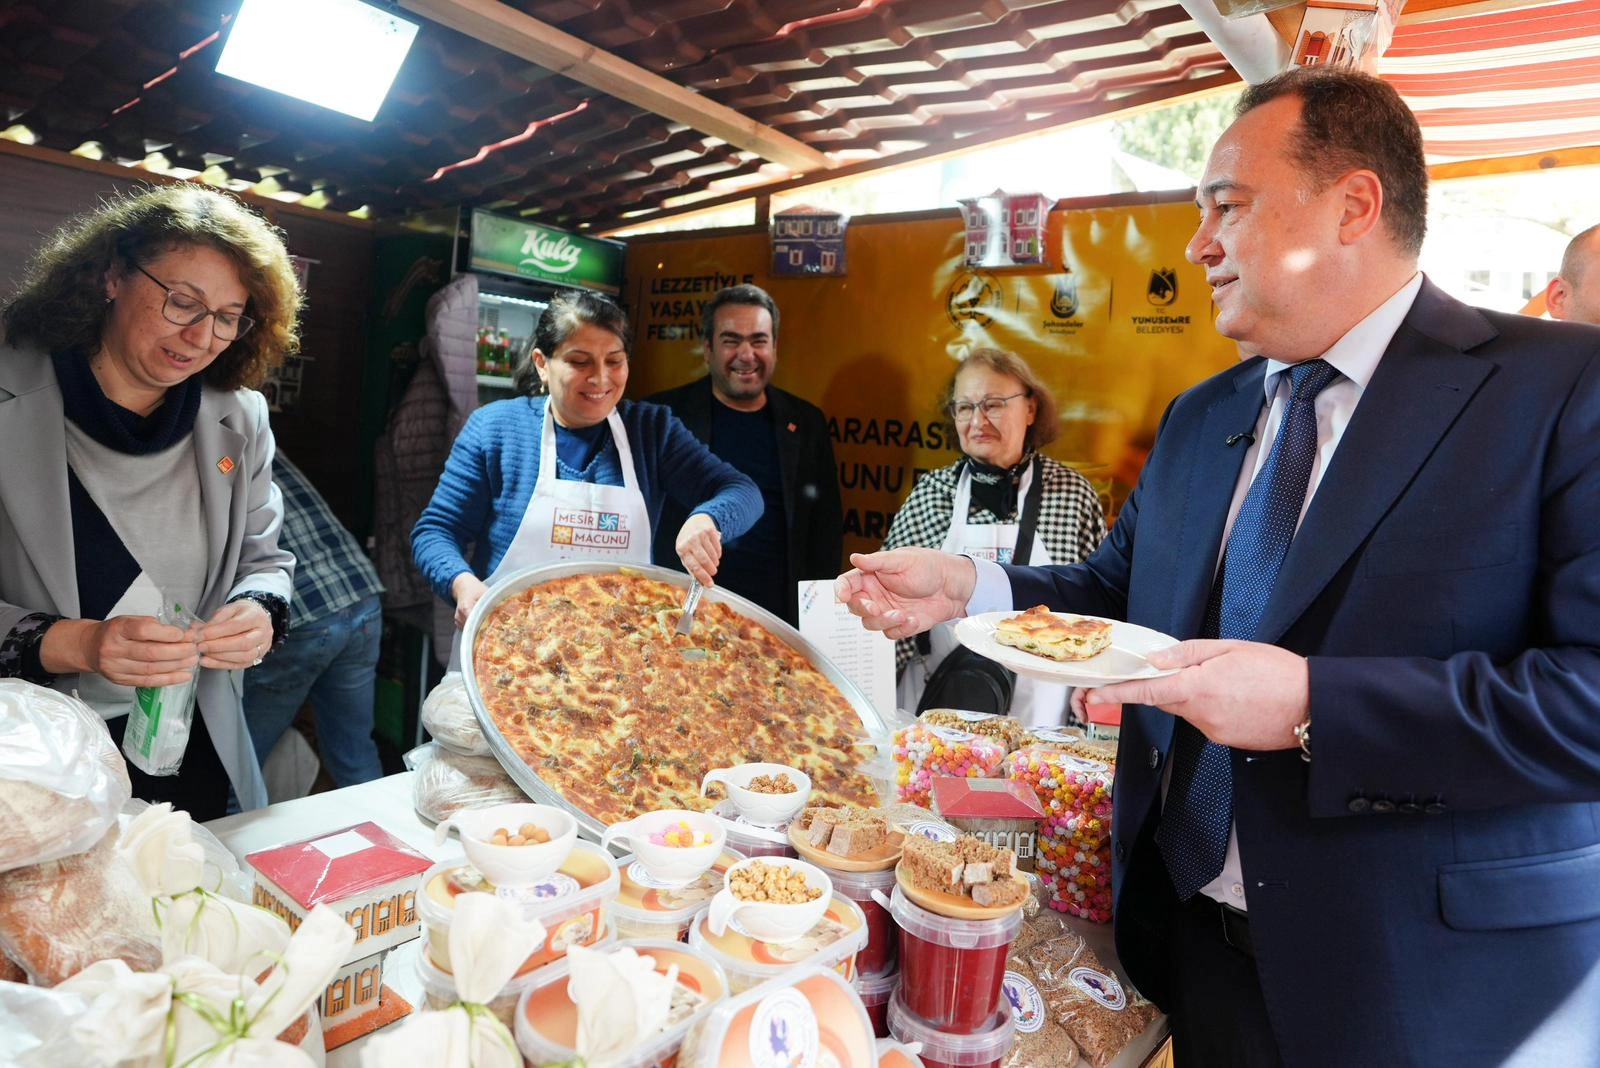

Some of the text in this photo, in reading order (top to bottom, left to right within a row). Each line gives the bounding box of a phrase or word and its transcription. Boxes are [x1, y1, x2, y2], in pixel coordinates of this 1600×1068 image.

[519, 229, 583, 265] Kula
[1131, 315, 1191, 325] YUNUSEMRE
[558, 513, 594, 526] MESİR
[574, 532, 627, 545] MACUNU
